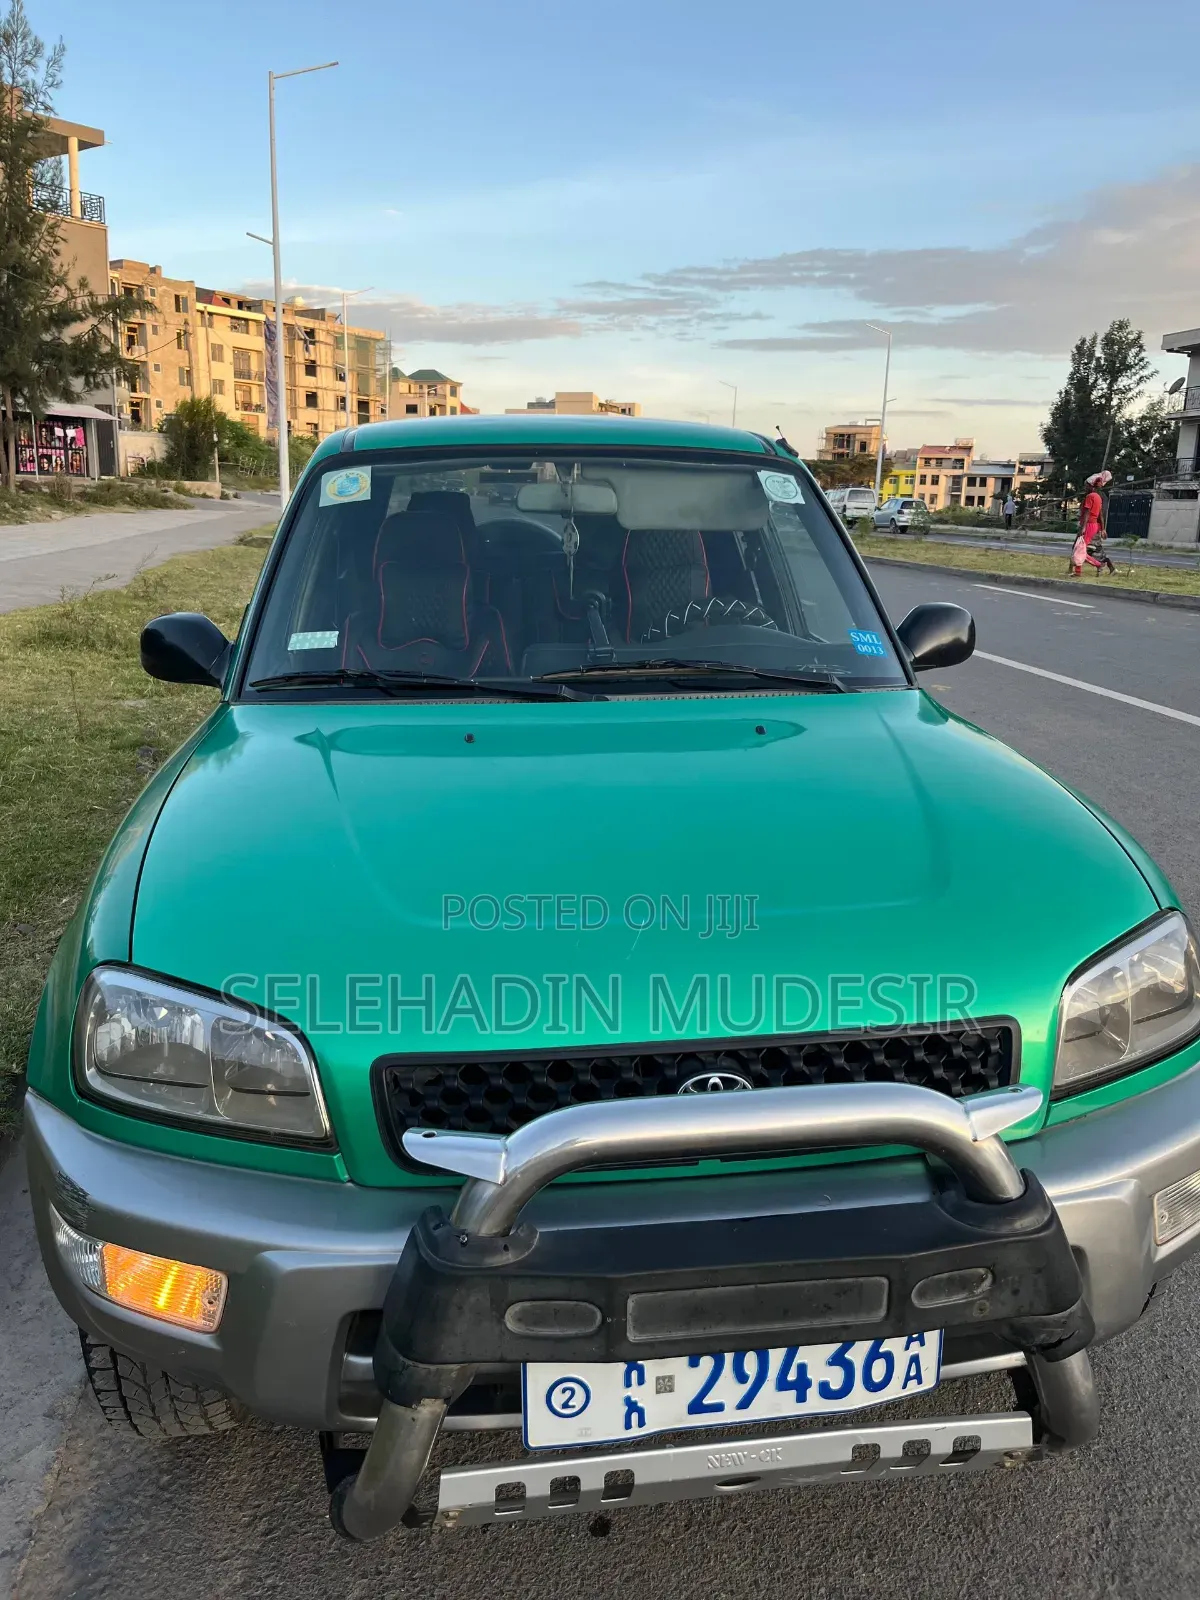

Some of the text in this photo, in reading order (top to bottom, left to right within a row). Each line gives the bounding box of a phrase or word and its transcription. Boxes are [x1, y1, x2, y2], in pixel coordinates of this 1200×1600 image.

[850, 631, 882, 645] SML
[857, 644, 884, 655] 0013
[687, 1339, 895, 1415] 29436
[561, 1386, 576, 1409] 2
